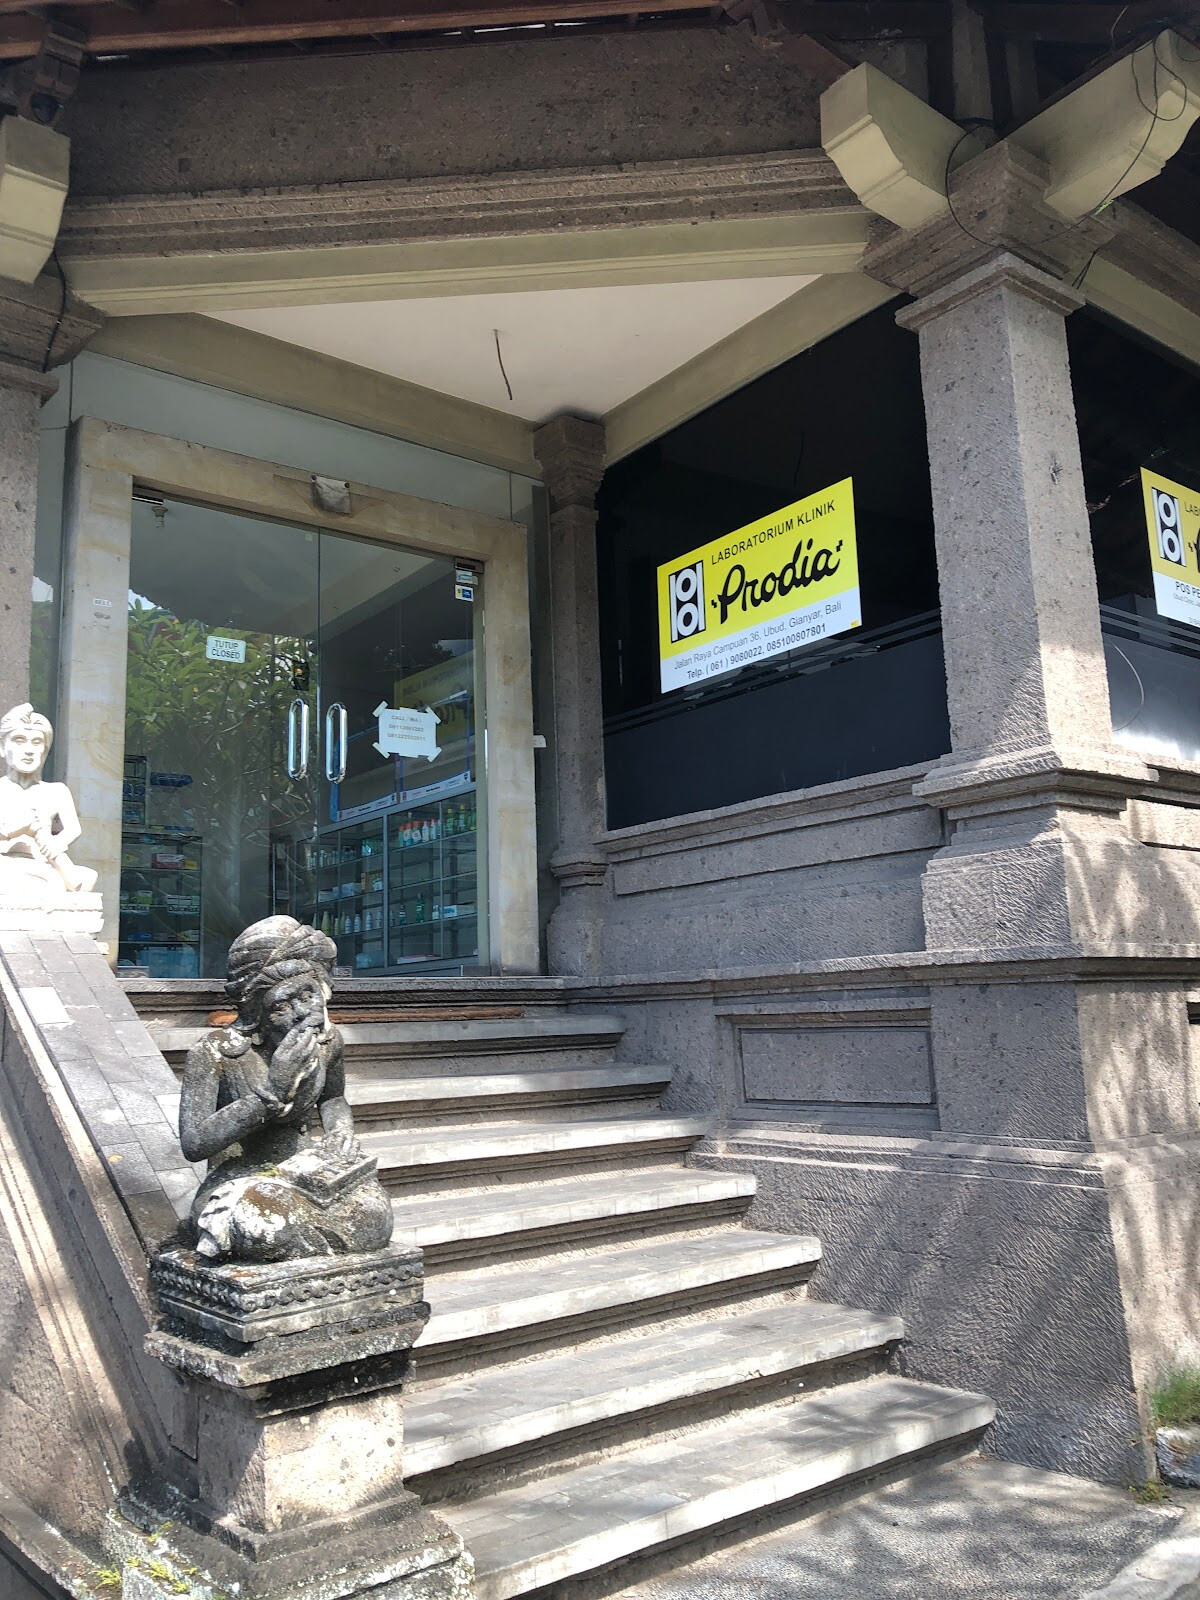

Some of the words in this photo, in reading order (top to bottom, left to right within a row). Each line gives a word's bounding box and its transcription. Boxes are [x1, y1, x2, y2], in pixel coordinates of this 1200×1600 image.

[711, 518, 794, 565] LABORATORIUM
[797, 499, 835, 527] KLINIK
[718, 538, 841, 624] Prodia
[1175, 581, 1190, 595] POS
[212, 649, 240, 659] CLOSED
[215, 640, 239, 649] TUTUP
[674, 657, 692, 670] Jalan
[693, 650, 712, 662] Raya
[713, 637, 748, 655] Campuan
[763, 621, 786, 637] Ubud,
[789, 610, 823, 628] Gianyar,
[825, 600, 842, 615] Bali
[687, 668, 704, 679] Telp.
[766, 623, 826, 652] 085100807801
